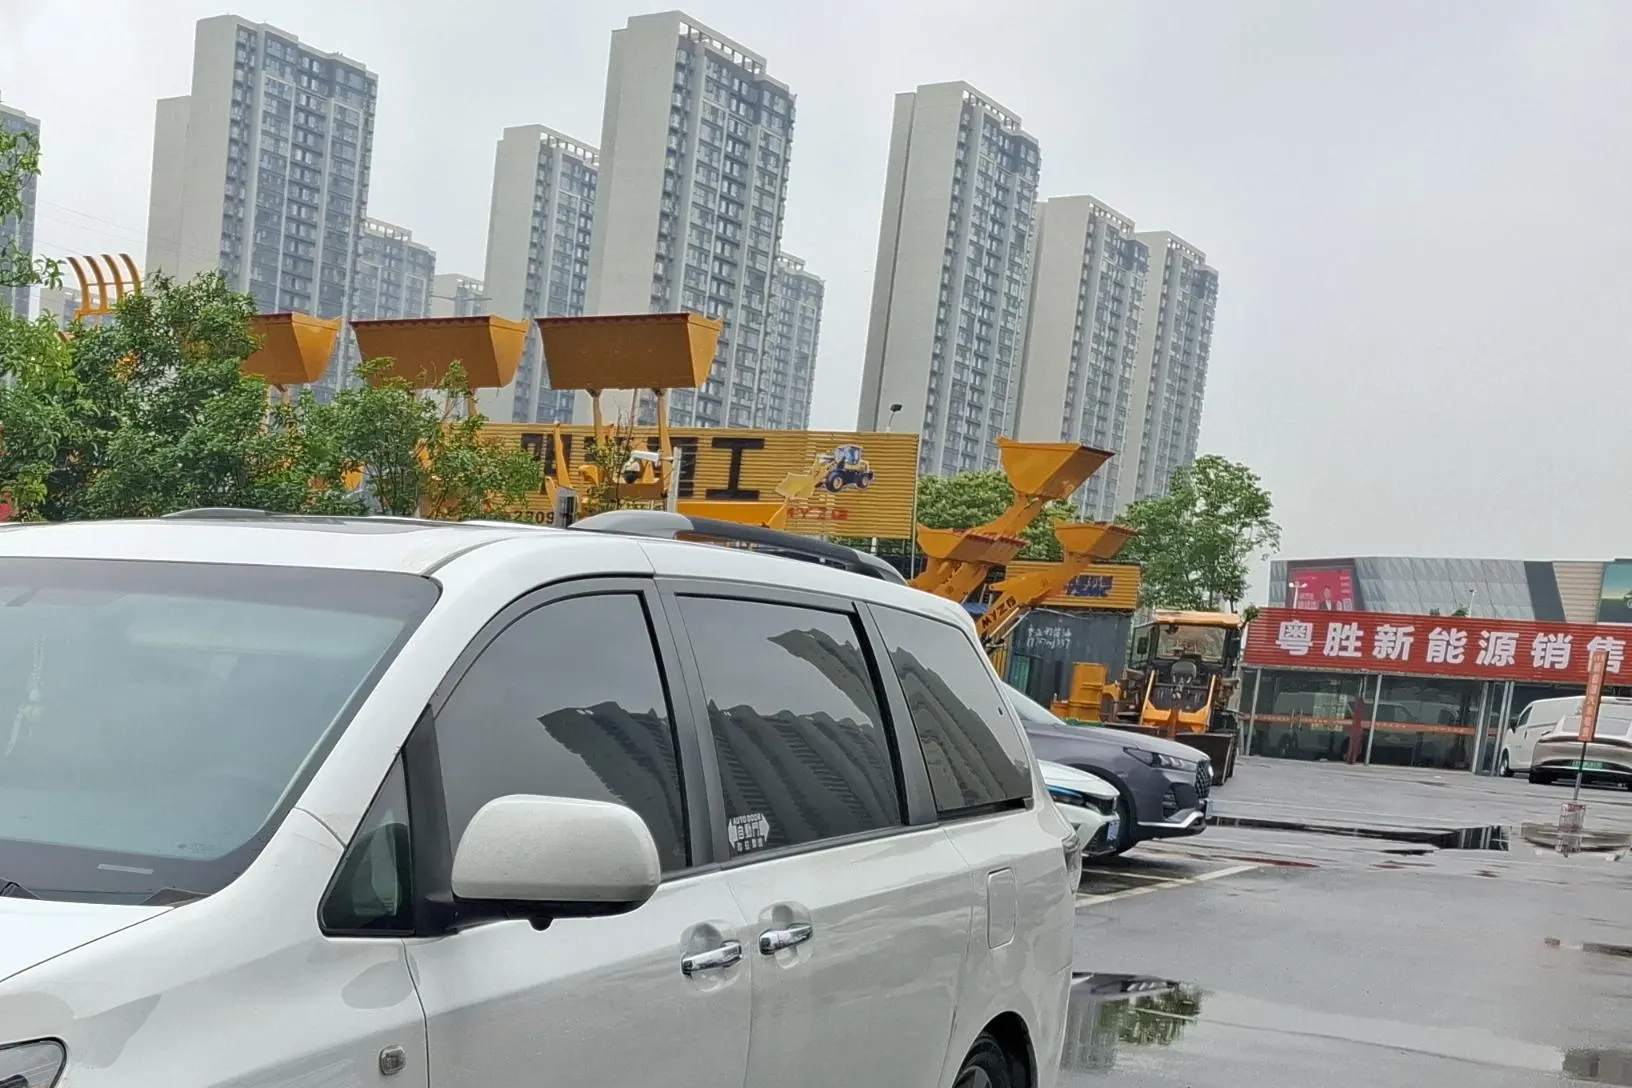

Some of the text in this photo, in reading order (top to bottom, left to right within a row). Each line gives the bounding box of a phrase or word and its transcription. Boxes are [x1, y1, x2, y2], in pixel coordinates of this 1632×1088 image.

[981, 596, 1017, 629] MYZG
[1275, 619, 1626, 674] 粤胜新能源销售
